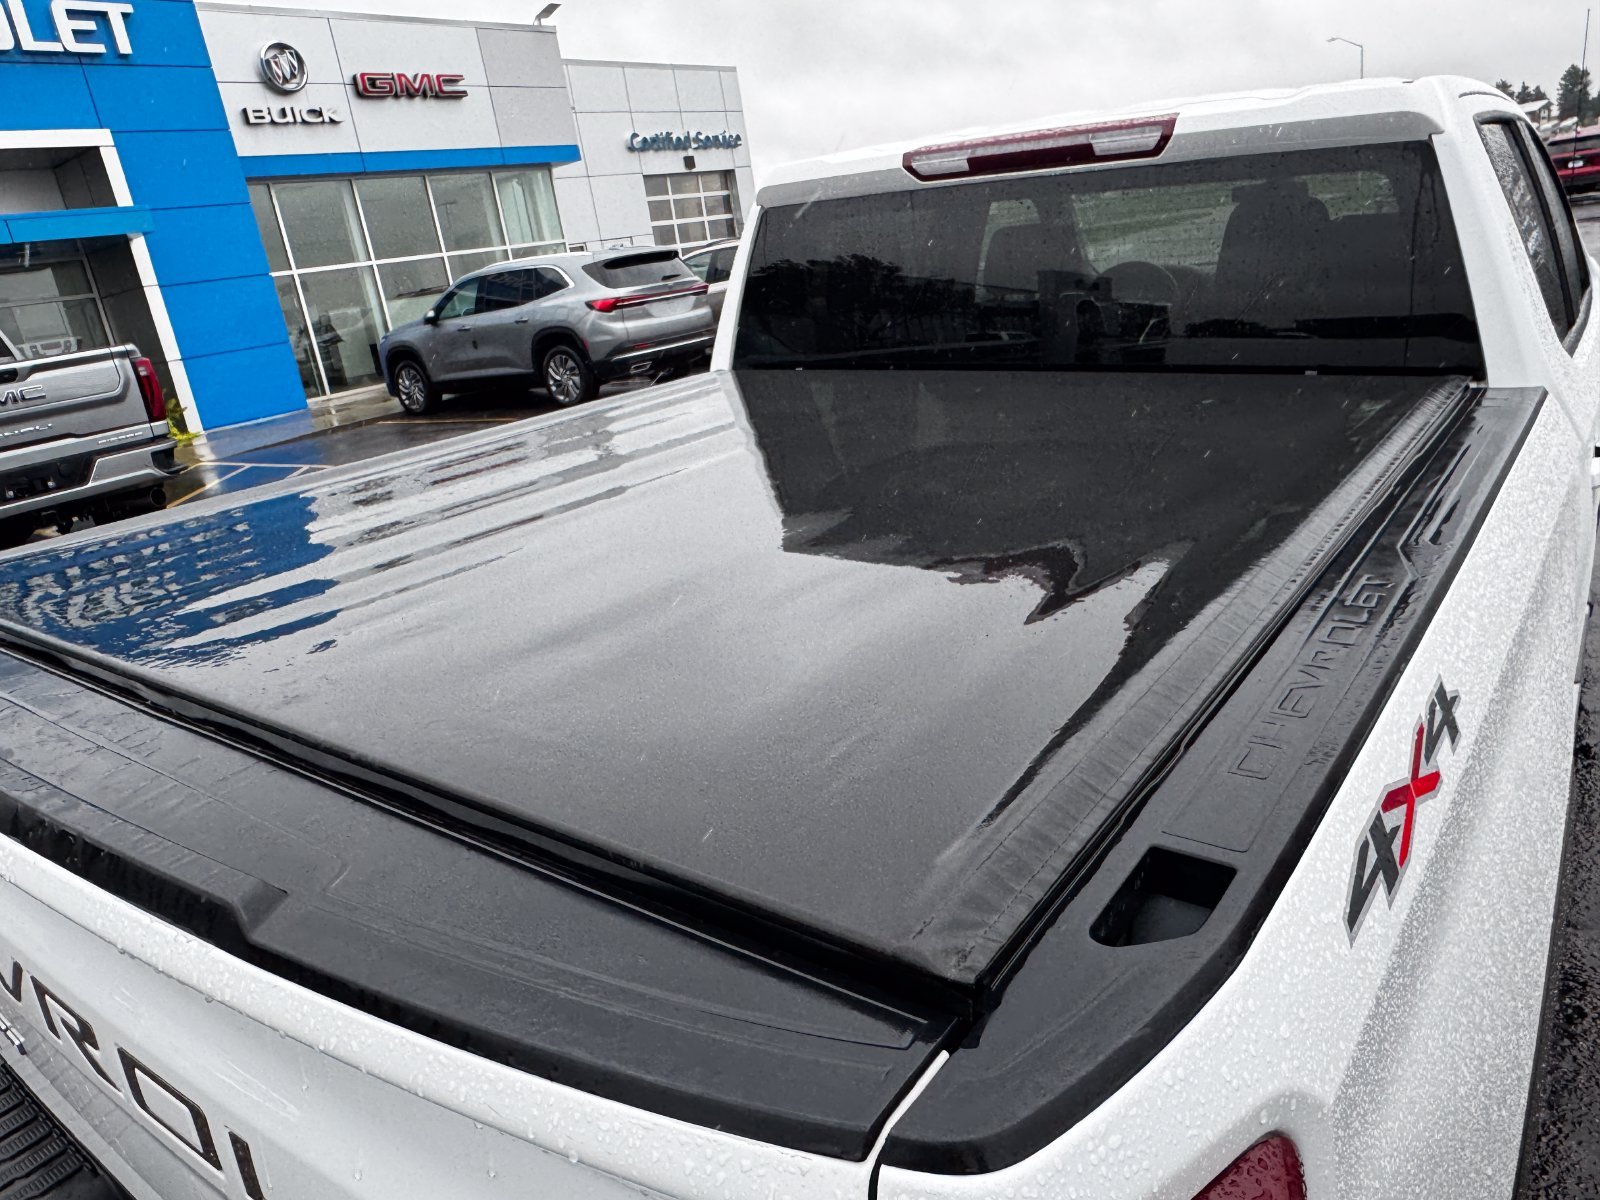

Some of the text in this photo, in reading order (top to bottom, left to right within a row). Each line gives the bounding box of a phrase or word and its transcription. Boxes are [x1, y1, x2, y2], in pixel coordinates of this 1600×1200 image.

[0, 0, 135, 55] LET
[354, 72, 468, 101] GMC
[242, 106, 344, 126] BUICK
[627, 130, 742, 152] Certified Service
[1227, 574, 1396, 780] CHEVROLET
